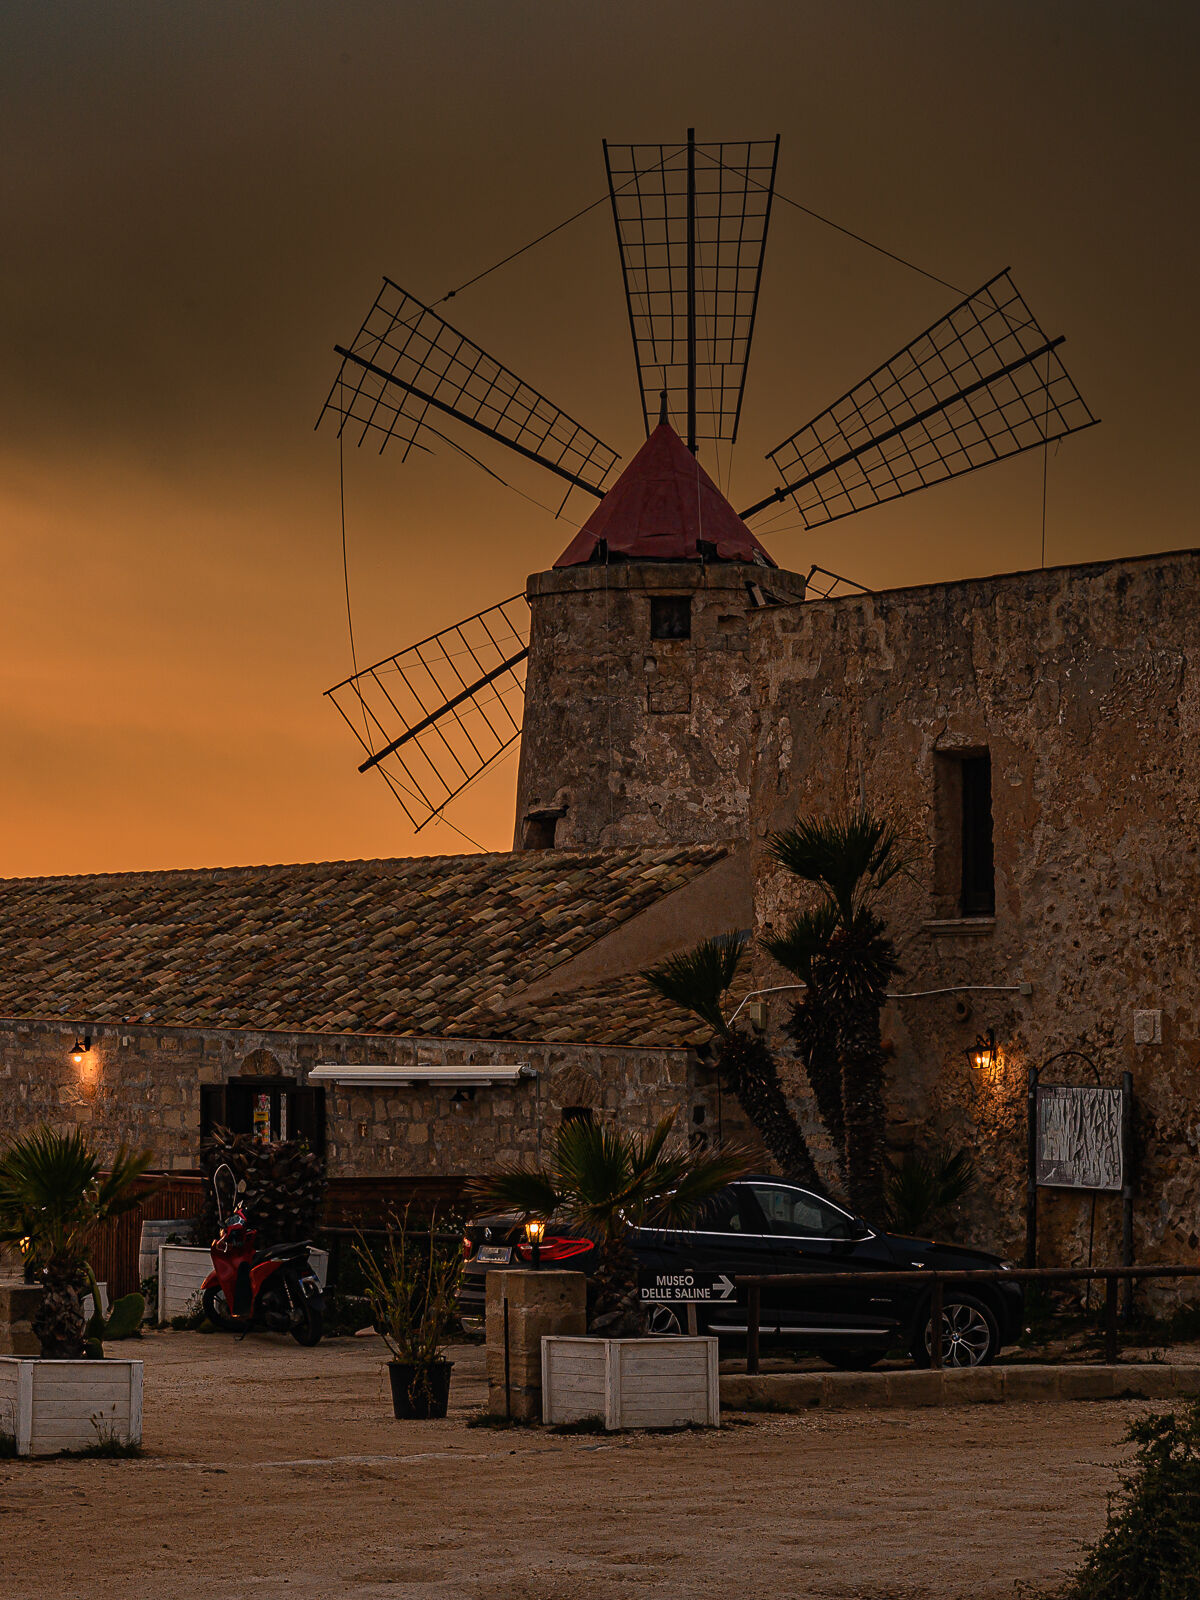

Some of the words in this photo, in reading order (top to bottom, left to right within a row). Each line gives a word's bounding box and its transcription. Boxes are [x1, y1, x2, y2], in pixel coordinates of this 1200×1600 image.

[656, 1275, 695, 1286] MUSEO
[641, 1288, 672, 1299] DELLE
[675, 1287, 711, 1299] SALINE
